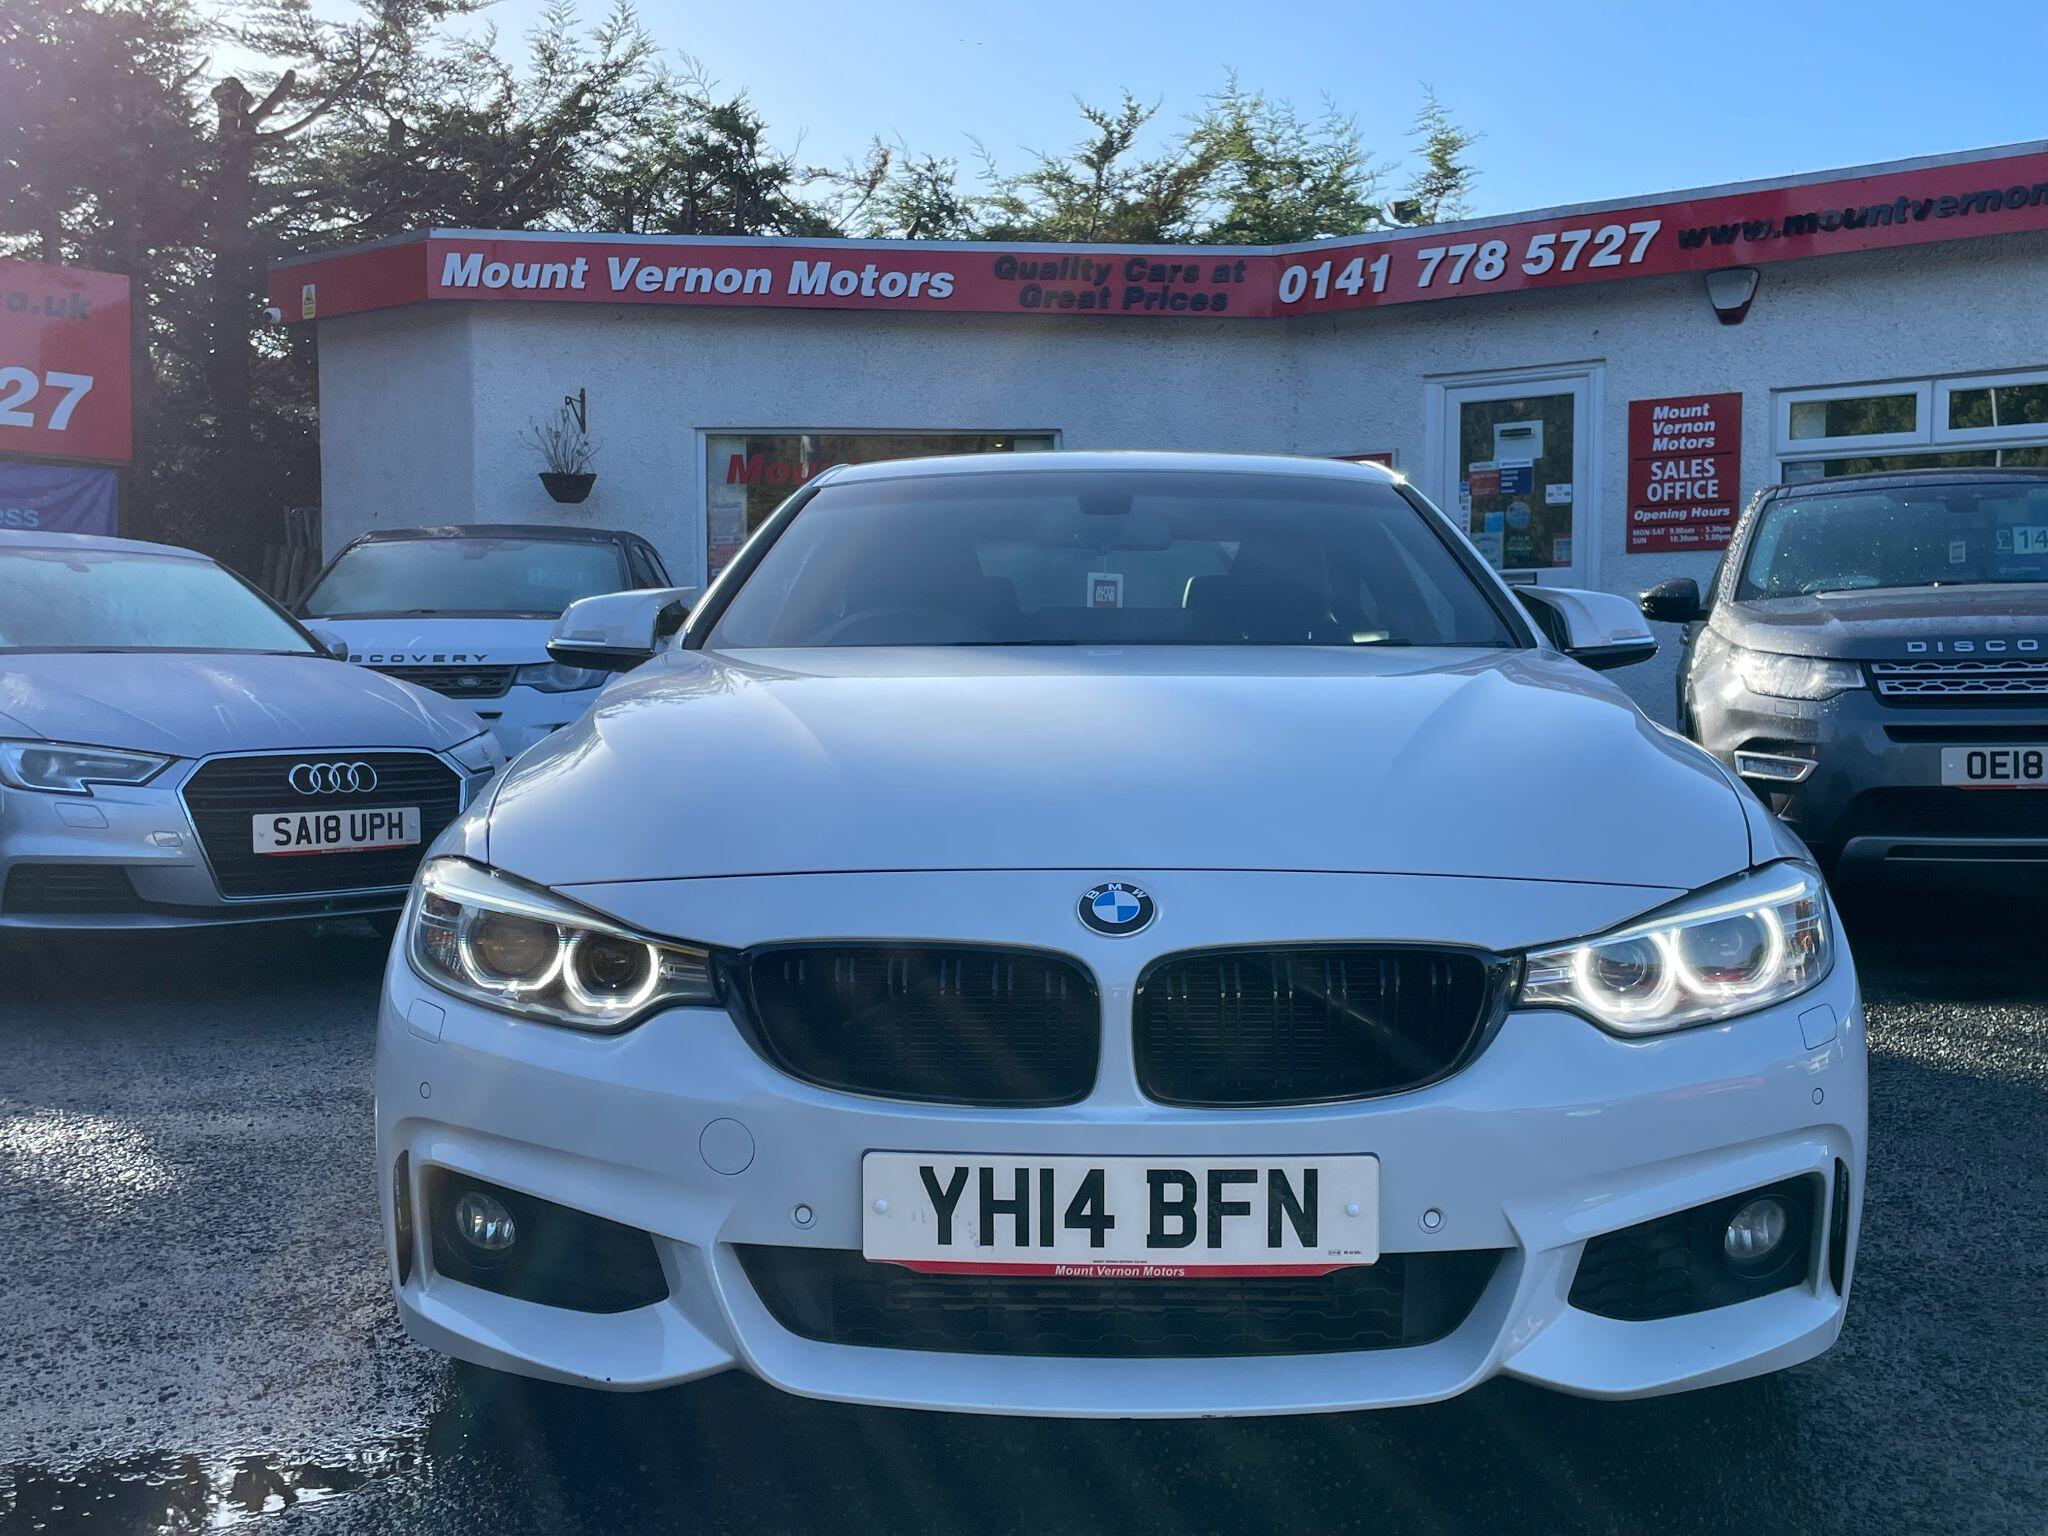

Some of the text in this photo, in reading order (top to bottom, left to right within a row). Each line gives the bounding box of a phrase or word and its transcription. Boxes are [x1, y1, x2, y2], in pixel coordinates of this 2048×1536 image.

[993, 255, 1246, 286] Quality Cars at
[1278, 219, 1662, 304] 0141 778 5727
[441, 252, 955, 299] Mount Vernon Motors
[1019, 284, 1228, 312] Great Prices
[0, 366, 94, 431] 27
[1653, 403, 1710, 420] Mount
[1652, 420, 1716, 436] Vernon
[1652, 436, 1716, 452] Motors
[1651, 458, 1716, 481] SALES
[1647, 480, 1719, 502] OFFICE
[1634, 507, 1730, 522] Opening Hours
[1632, 537, 1648, 545] SUN
[1907, 639, 2039, 653] DISCO
[1967, 751, 2043, 779] OE18
[273, 812, 404, 846] SA18 UPH
[1085, 883, 1148, 900] BMW
[918, 1165, 1319, 1249] YH14 BFN
[1055, 1265, 1185, 1277] Mount Vernon Motors
